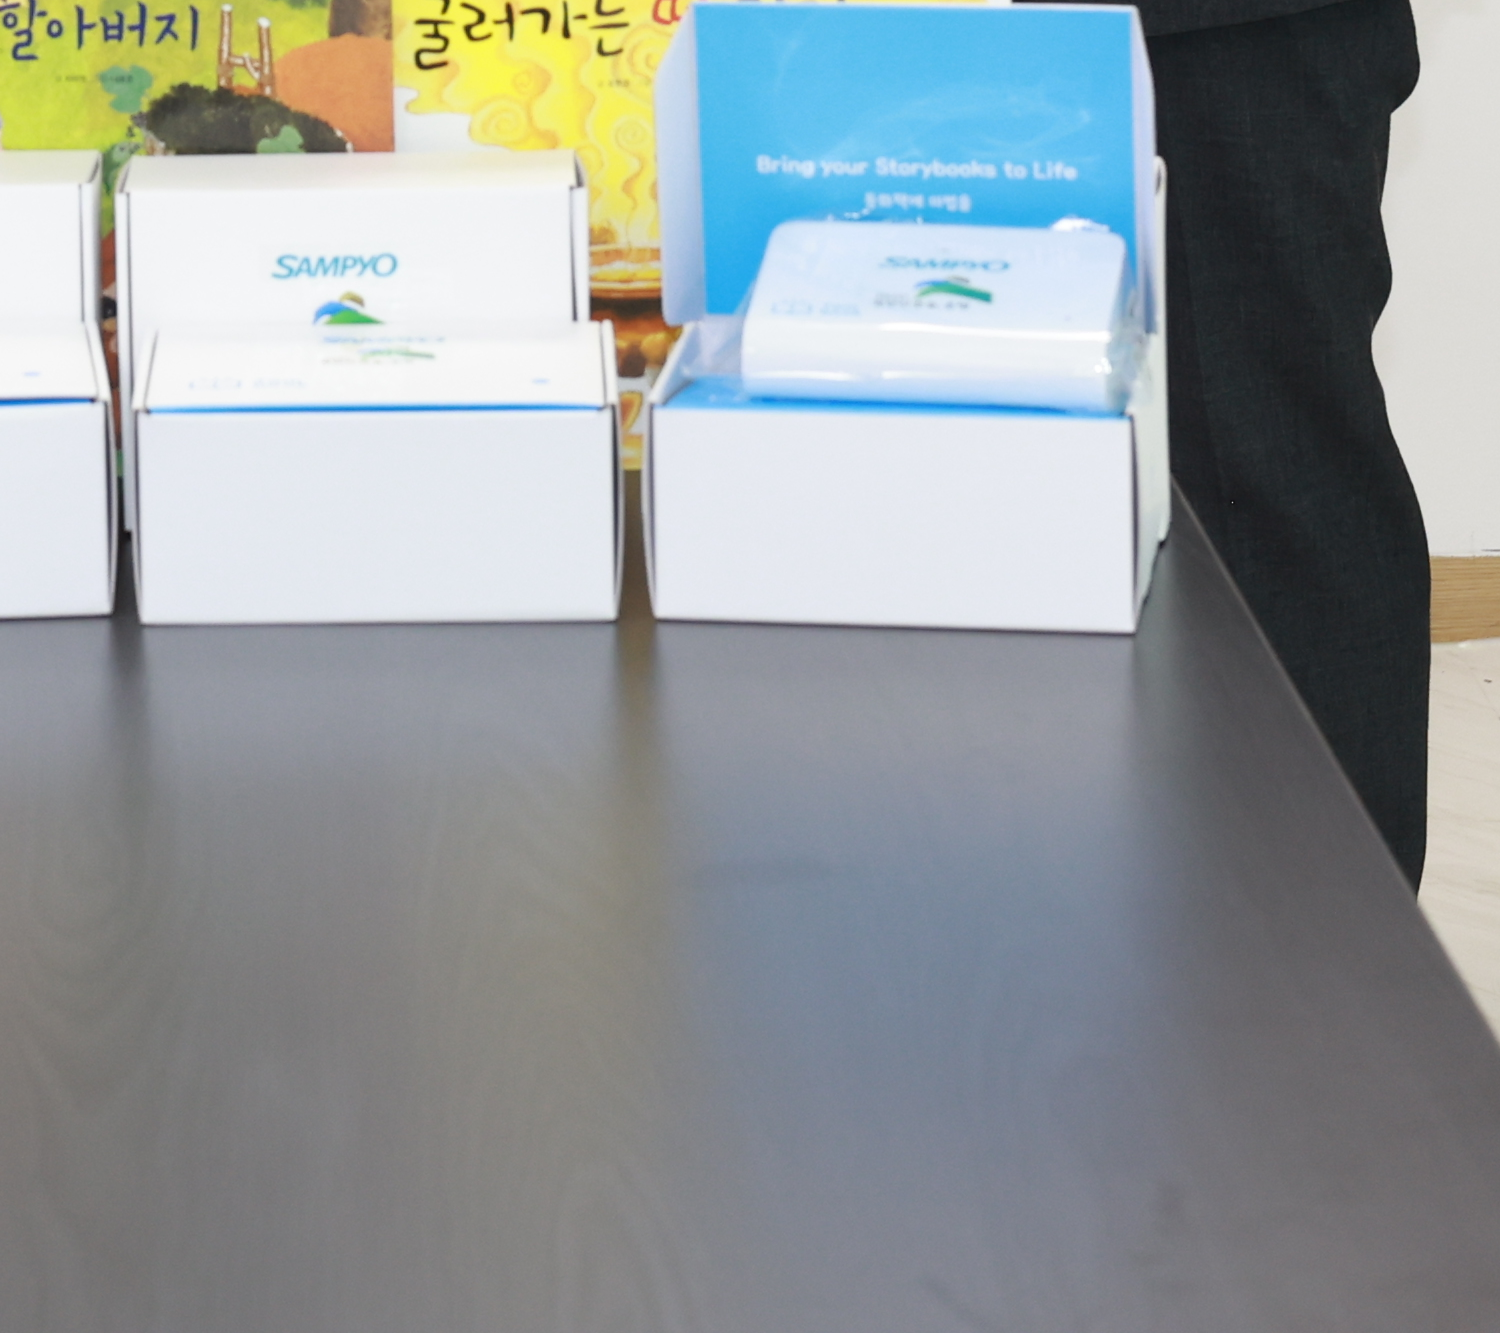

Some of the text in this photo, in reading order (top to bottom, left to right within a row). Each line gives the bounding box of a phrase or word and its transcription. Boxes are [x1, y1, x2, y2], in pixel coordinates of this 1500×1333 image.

[757, 155, 1078, 180] Bring your Storybooks to Life
[271, 252, 399, 280] SAMPYO
